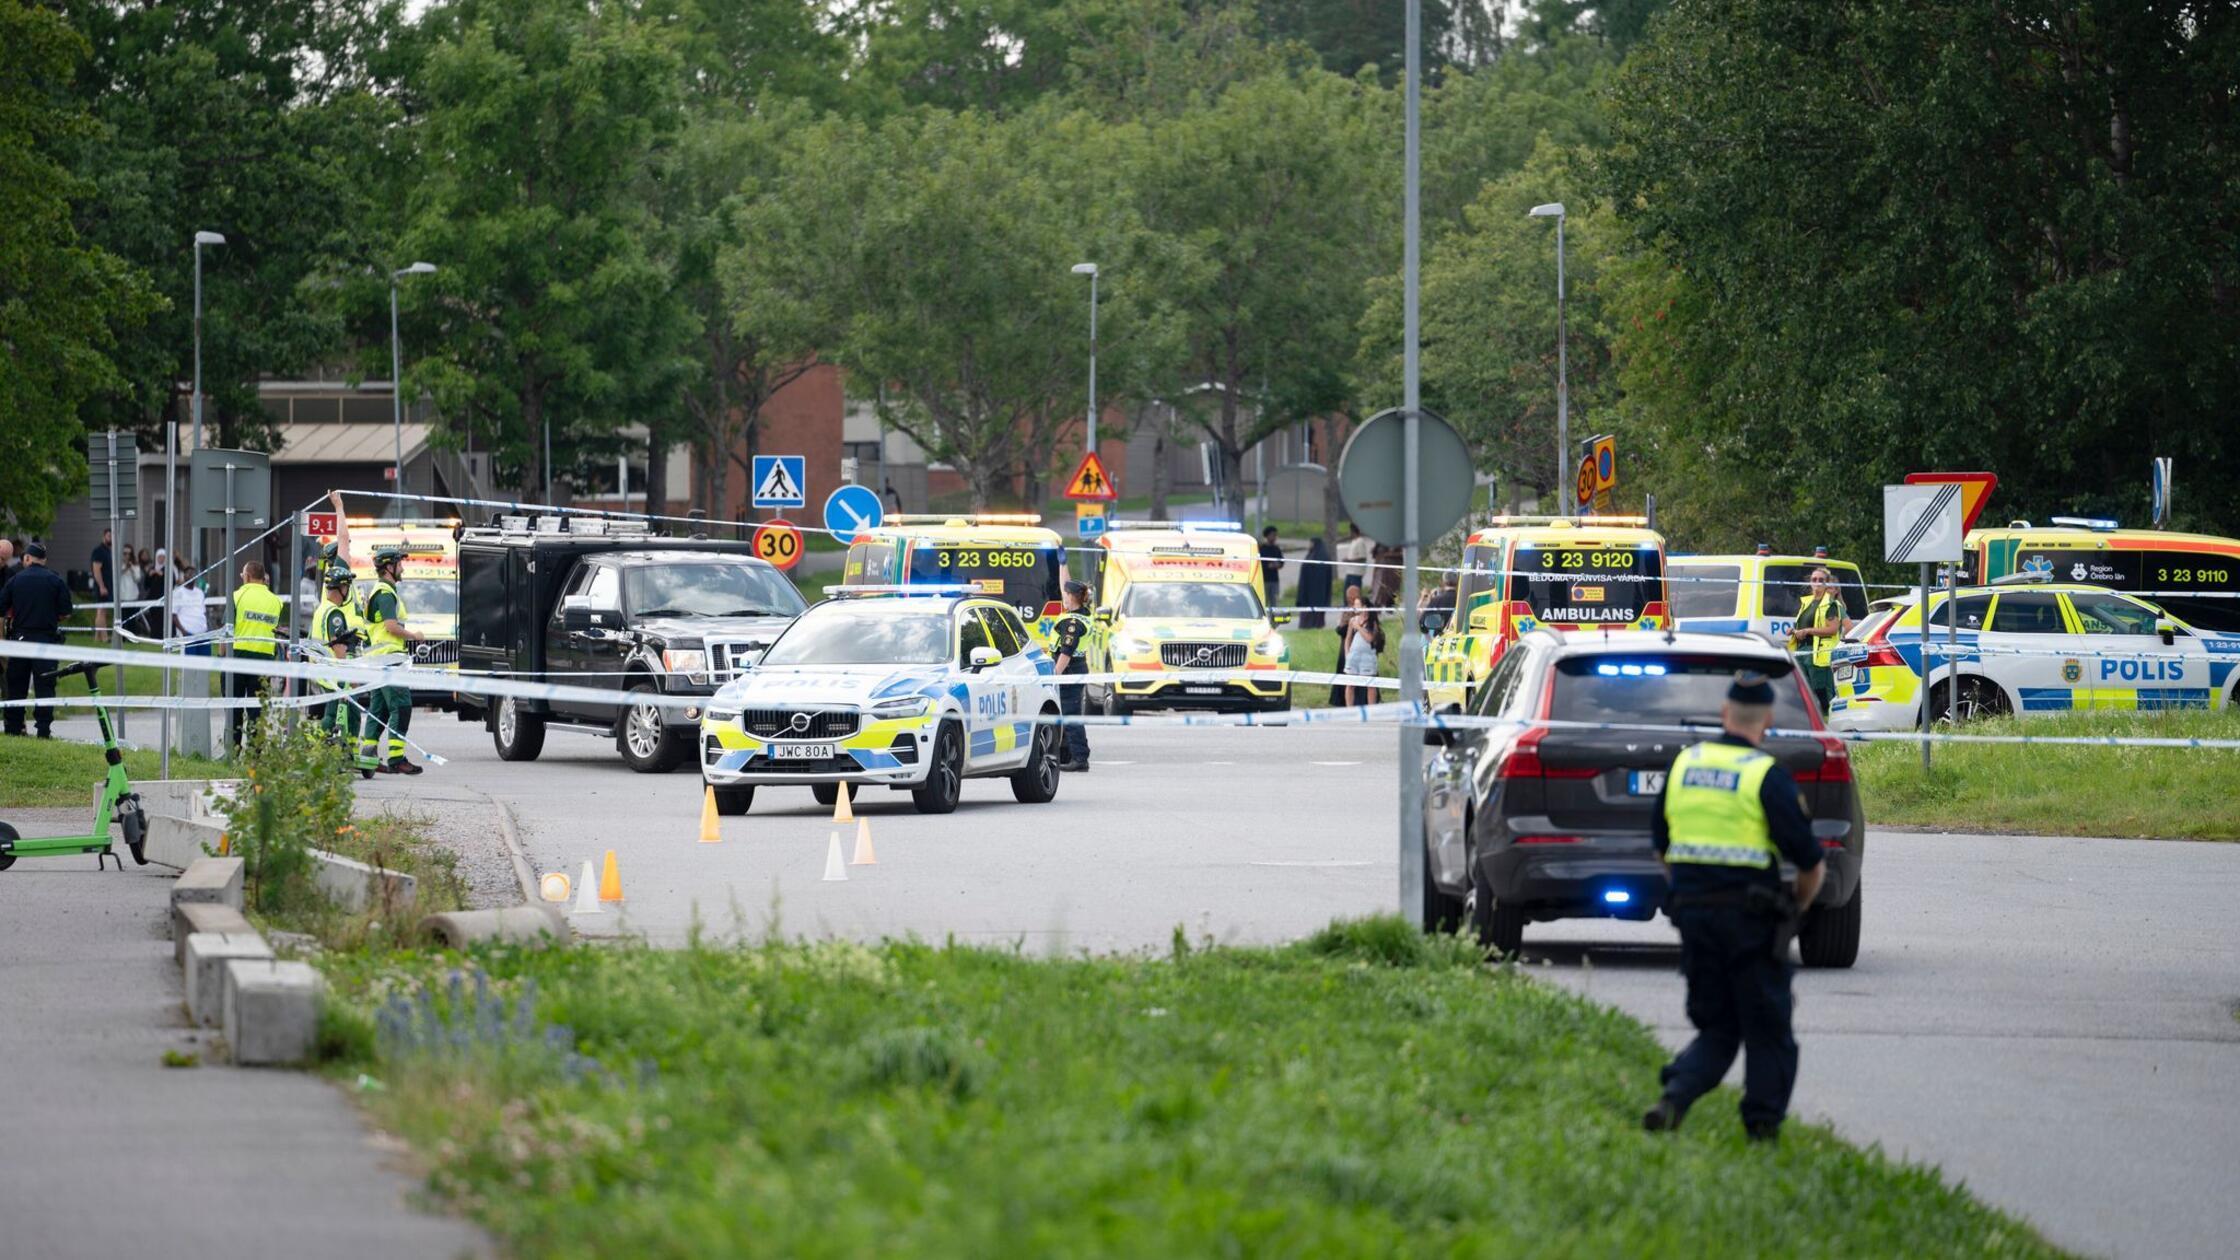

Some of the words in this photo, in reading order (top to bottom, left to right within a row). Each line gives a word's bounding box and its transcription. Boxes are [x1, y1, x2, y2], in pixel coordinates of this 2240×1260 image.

[1580, 467, 1594, 492] 30
[762, 533, 796, 557] 30
[938, 552, 950, 567] 3
[958, 552, 981, 567] 23
[988, 552, 1036, 567] 9650
[1542, 552, 1554, 568] 3
[1561, 552, 1584, 568] 23
[1591, 552, 1633, 568] 9120
[2090, 565, 2113, 573] Region
[2158, 569, 2168, 582] 3
[2173, 569, 2191, 582] 23
[2197, 570, 2228, 583] 9110
[1541, 608, 1634, 620] AMBULANS
[2100, 659, 2184, 681] POLIS
[978, 690, 1007, 717] POLIS
[779, 745, 801, 757] JWC
[805, 745, 829, 757] 80A
